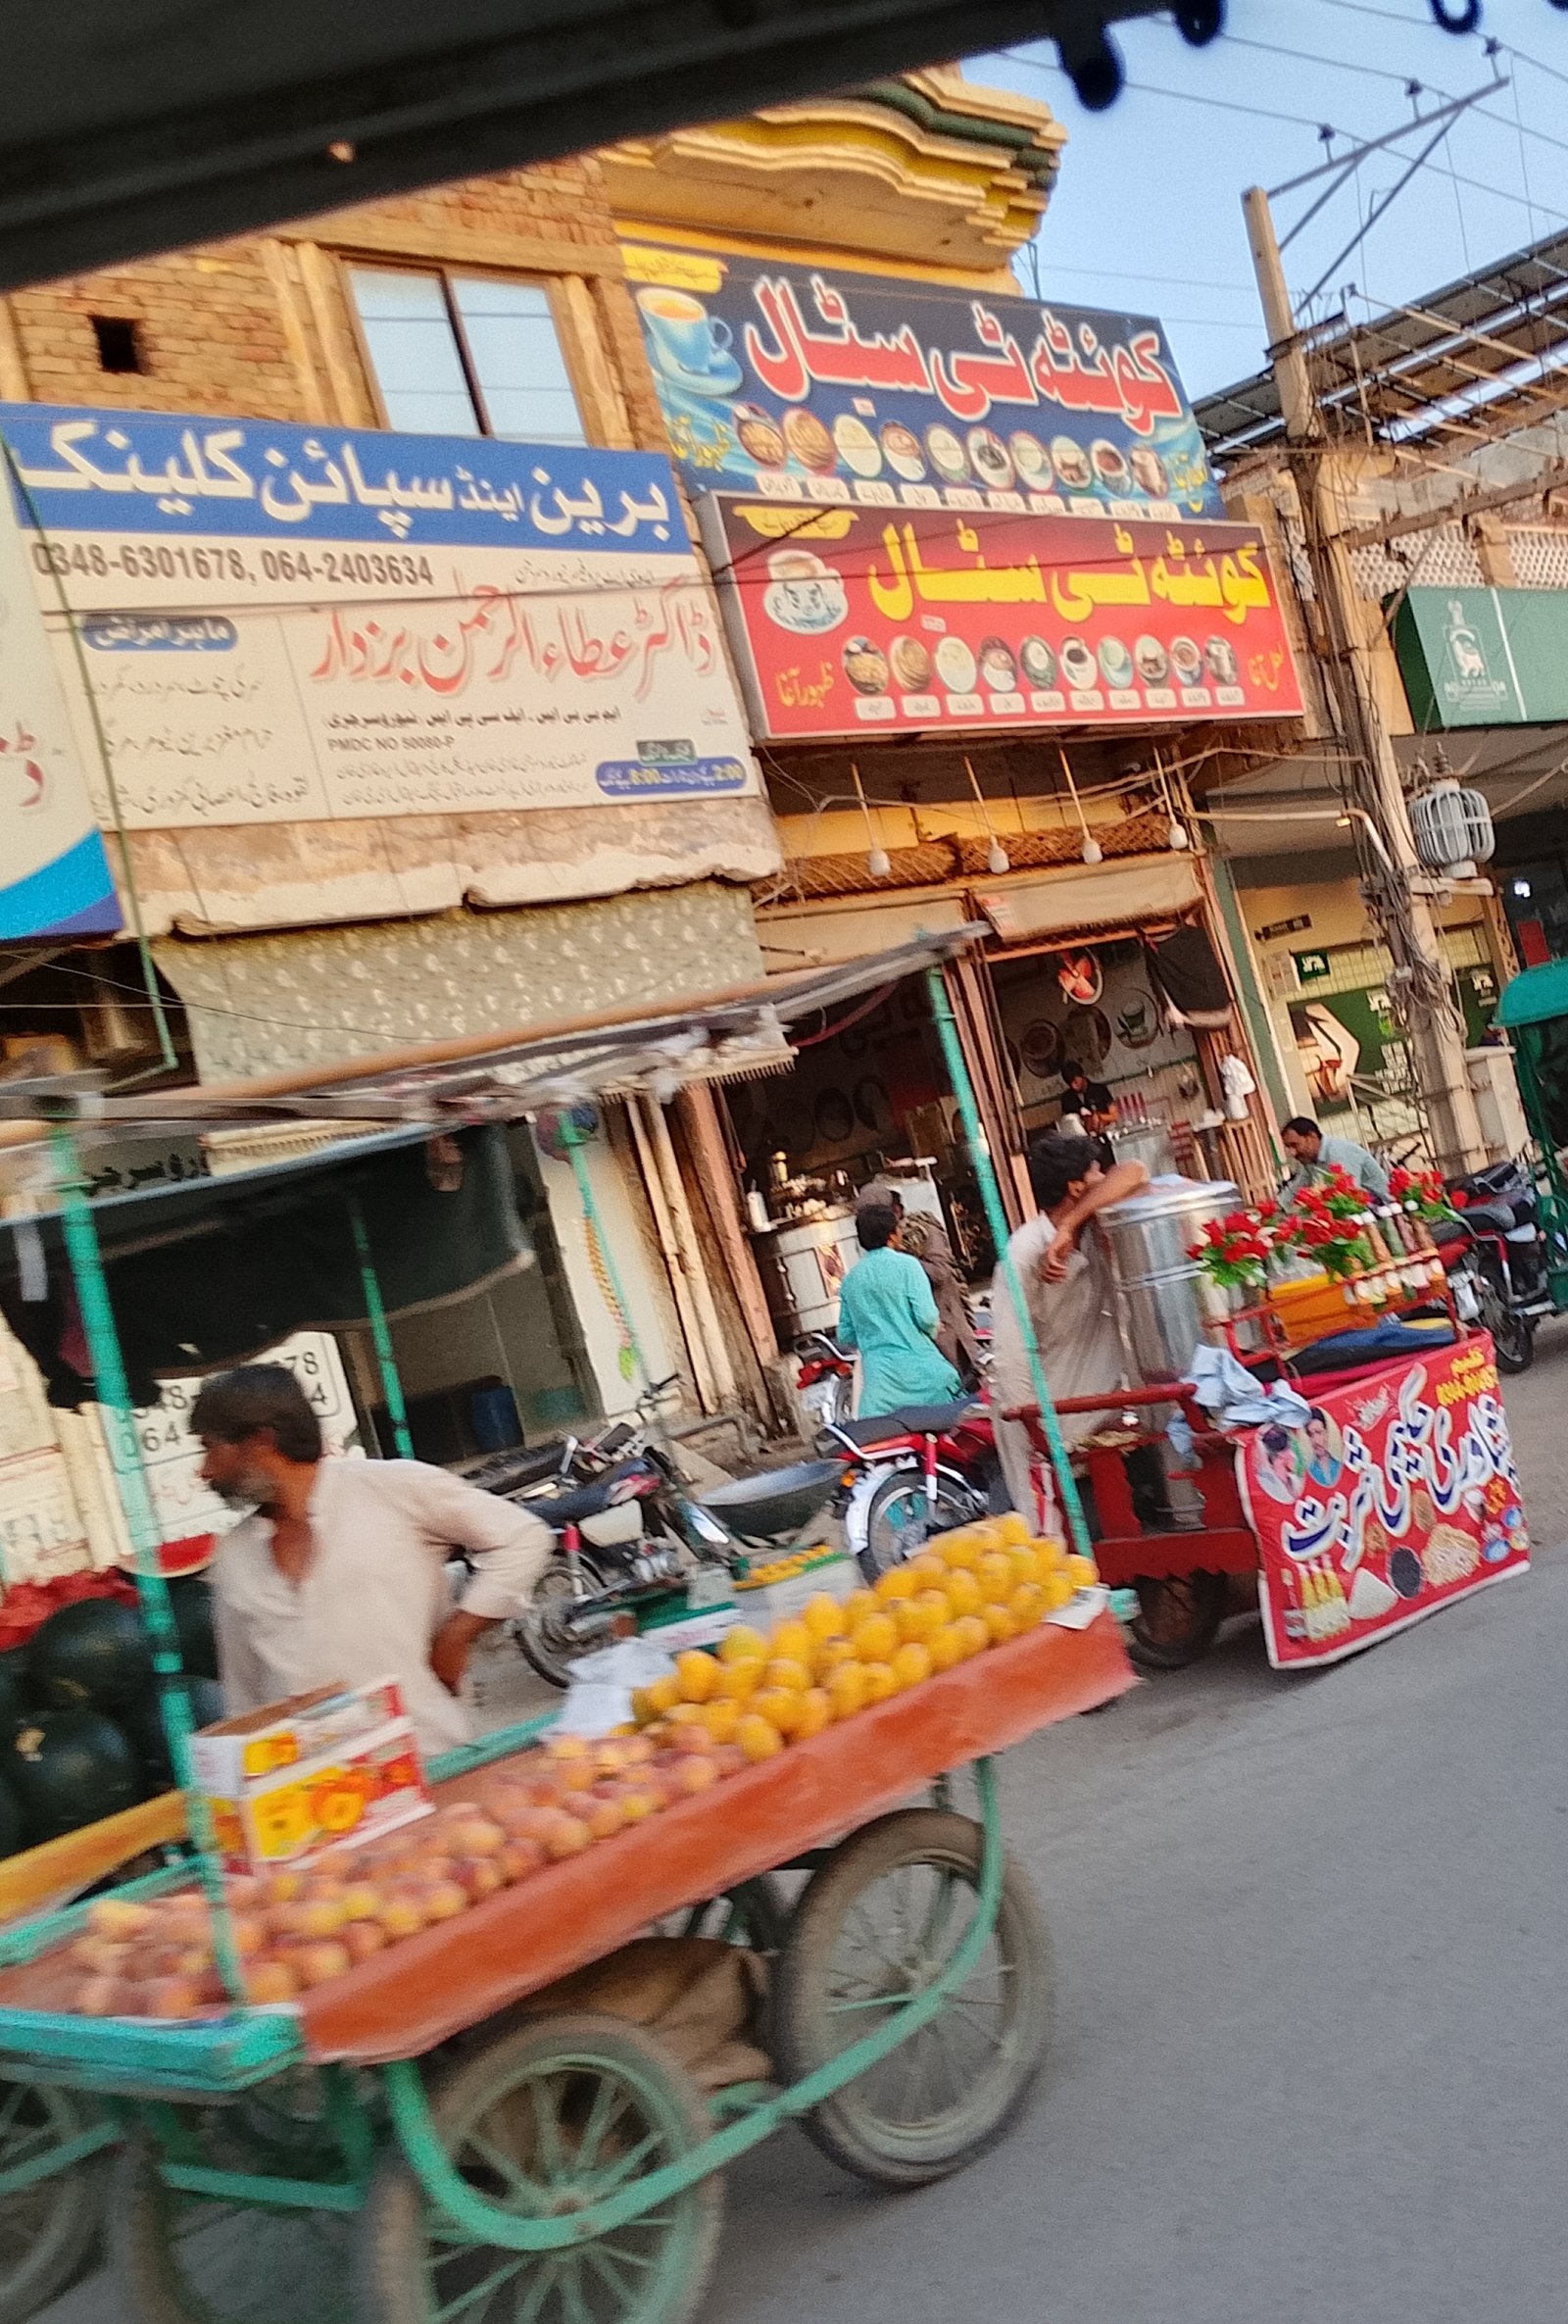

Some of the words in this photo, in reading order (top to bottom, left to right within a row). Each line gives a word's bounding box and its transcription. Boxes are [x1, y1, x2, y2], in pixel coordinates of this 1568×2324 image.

[743, 272, 936, 403] سٹال
[929, 299, 1040, 422] ٹی
[1029, 309, 1184, 436] کوئٹہ
[12, 420, 255, 517] کلینک
[261, 437, 455, 541] سپائن
[455, 464, 524, 522] اینڈ
[529, 465, 671, 542] برین
[261, 547, 435, 585] 064-2403634
[867, 518, 1048, 622] سٹال
[1051, 521, 1152, 623] ٹی
[1150, 529, 1272, 625] کوئٹہ
[309, 605, 415, 687] بزدار
[633, 574, 712, 702] ڈاکٹر
